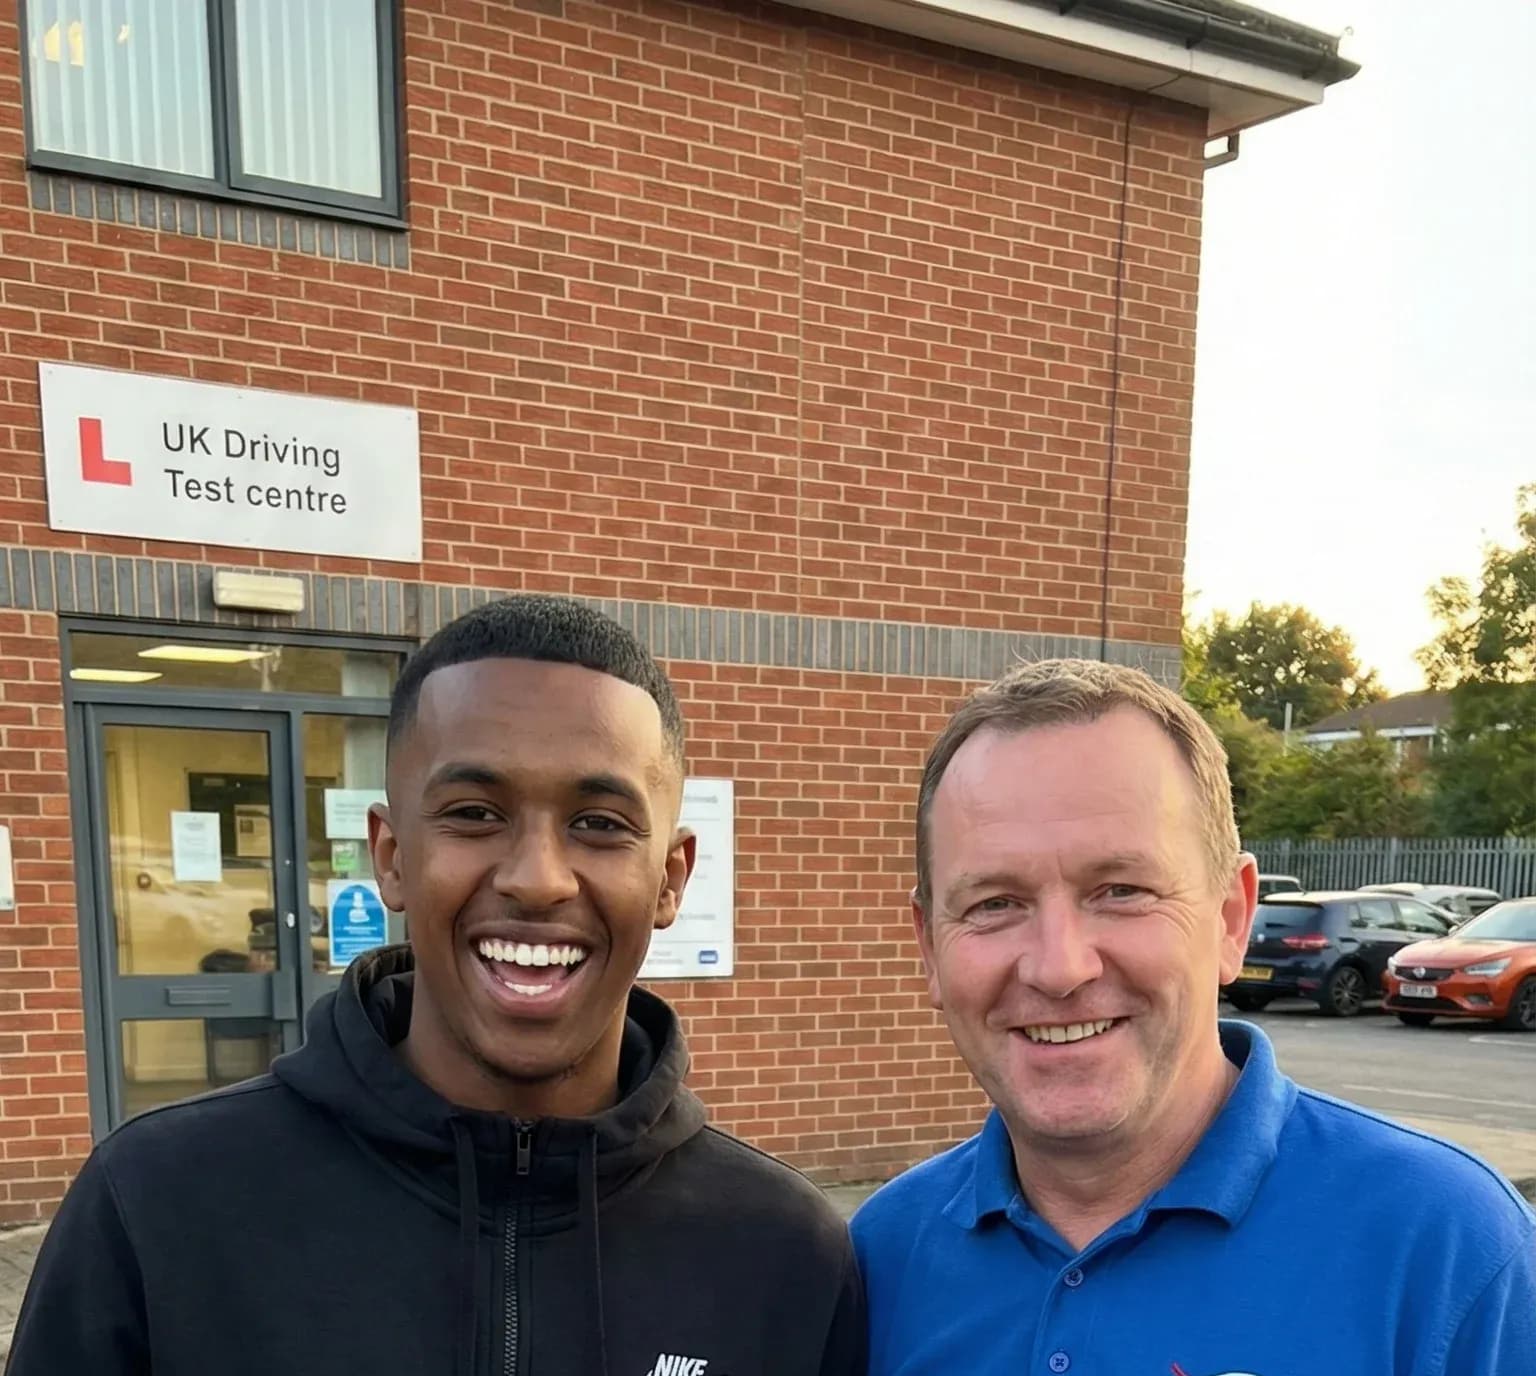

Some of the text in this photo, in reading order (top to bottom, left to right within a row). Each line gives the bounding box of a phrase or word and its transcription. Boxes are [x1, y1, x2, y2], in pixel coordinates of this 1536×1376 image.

[79, 417, 132, 486] L
[163, 422, 340, 477] UK Driving
[164, 468, 347, 514] Test centre
